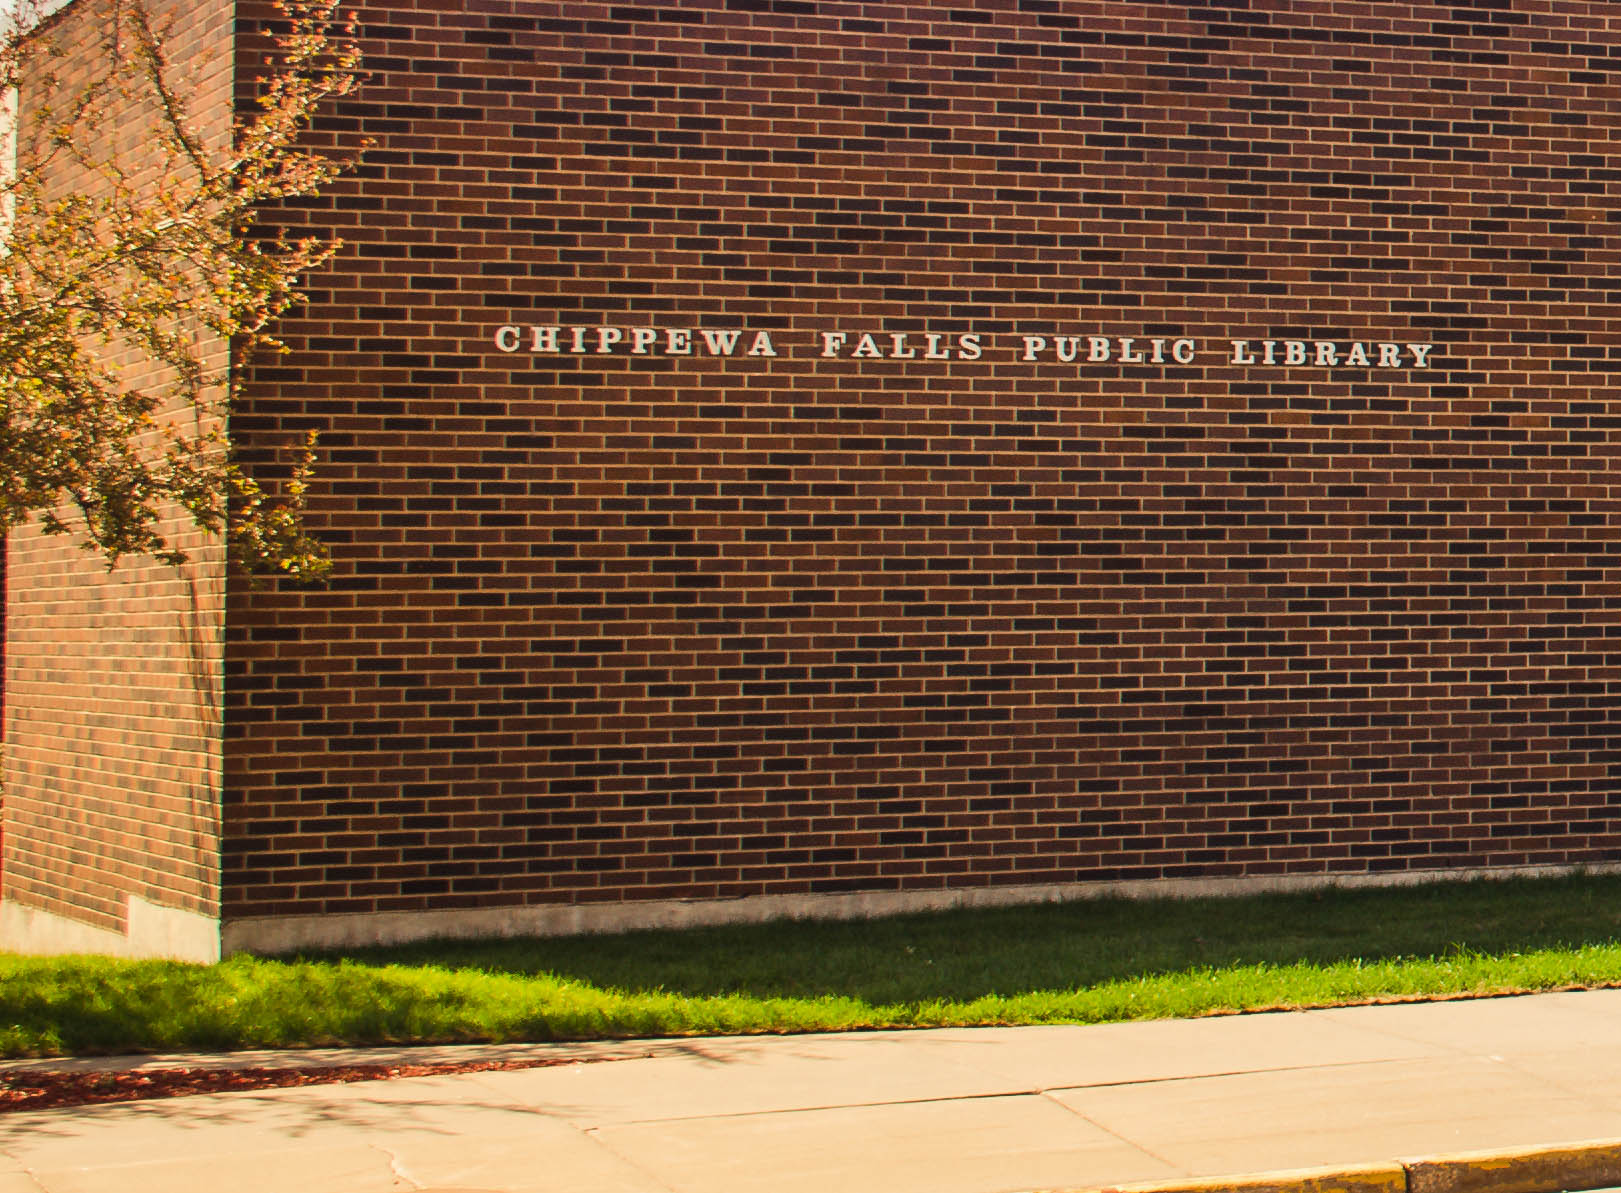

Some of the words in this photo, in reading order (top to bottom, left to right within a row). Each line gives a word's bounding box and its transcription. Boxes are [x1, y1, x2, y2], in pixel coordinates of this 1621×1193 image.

[493, 326, 777, 356] CHIPPEWA
[820, 332, 983, 360] FALLS
[1022, 336, 1195, 364] PUBLIC
[1230, 340, 1432, 367] LIBRARY
